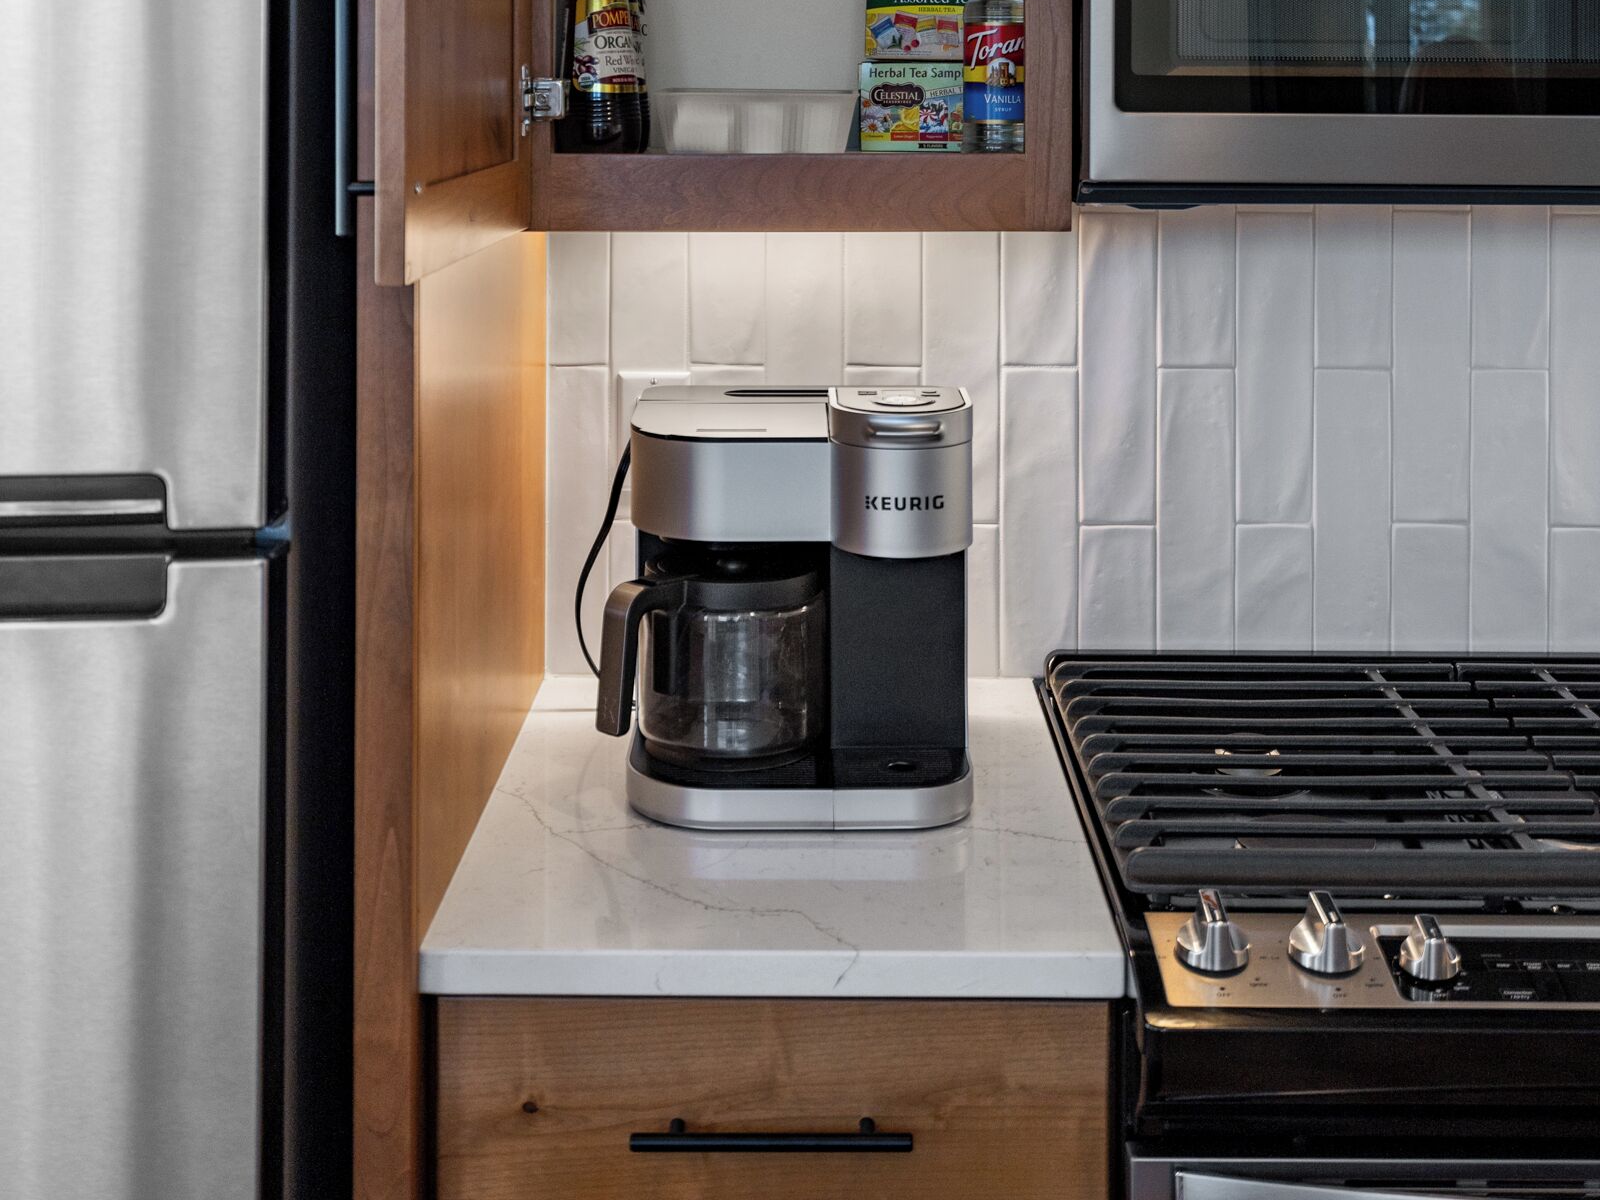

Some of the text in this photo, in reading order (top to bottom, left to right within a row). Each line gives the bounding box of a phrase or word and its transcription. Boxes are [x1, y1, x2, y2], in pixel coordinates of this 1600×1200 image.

[592, 10, 629, 28] POMPE
[594, 35, 632, 49] ORGA
[967, 27, 1024, 71] Toran
[605, 55, 623, 66] Red
[869, 67, 963, 80] Herbal Tea Samp
[874, 89, 921, 102] CELESTIAL
[929, 88, 956, 97] HERBAL
[984, 93, 1022, 104] VANILLA
[865, 495, 944, 511] KEURIG
